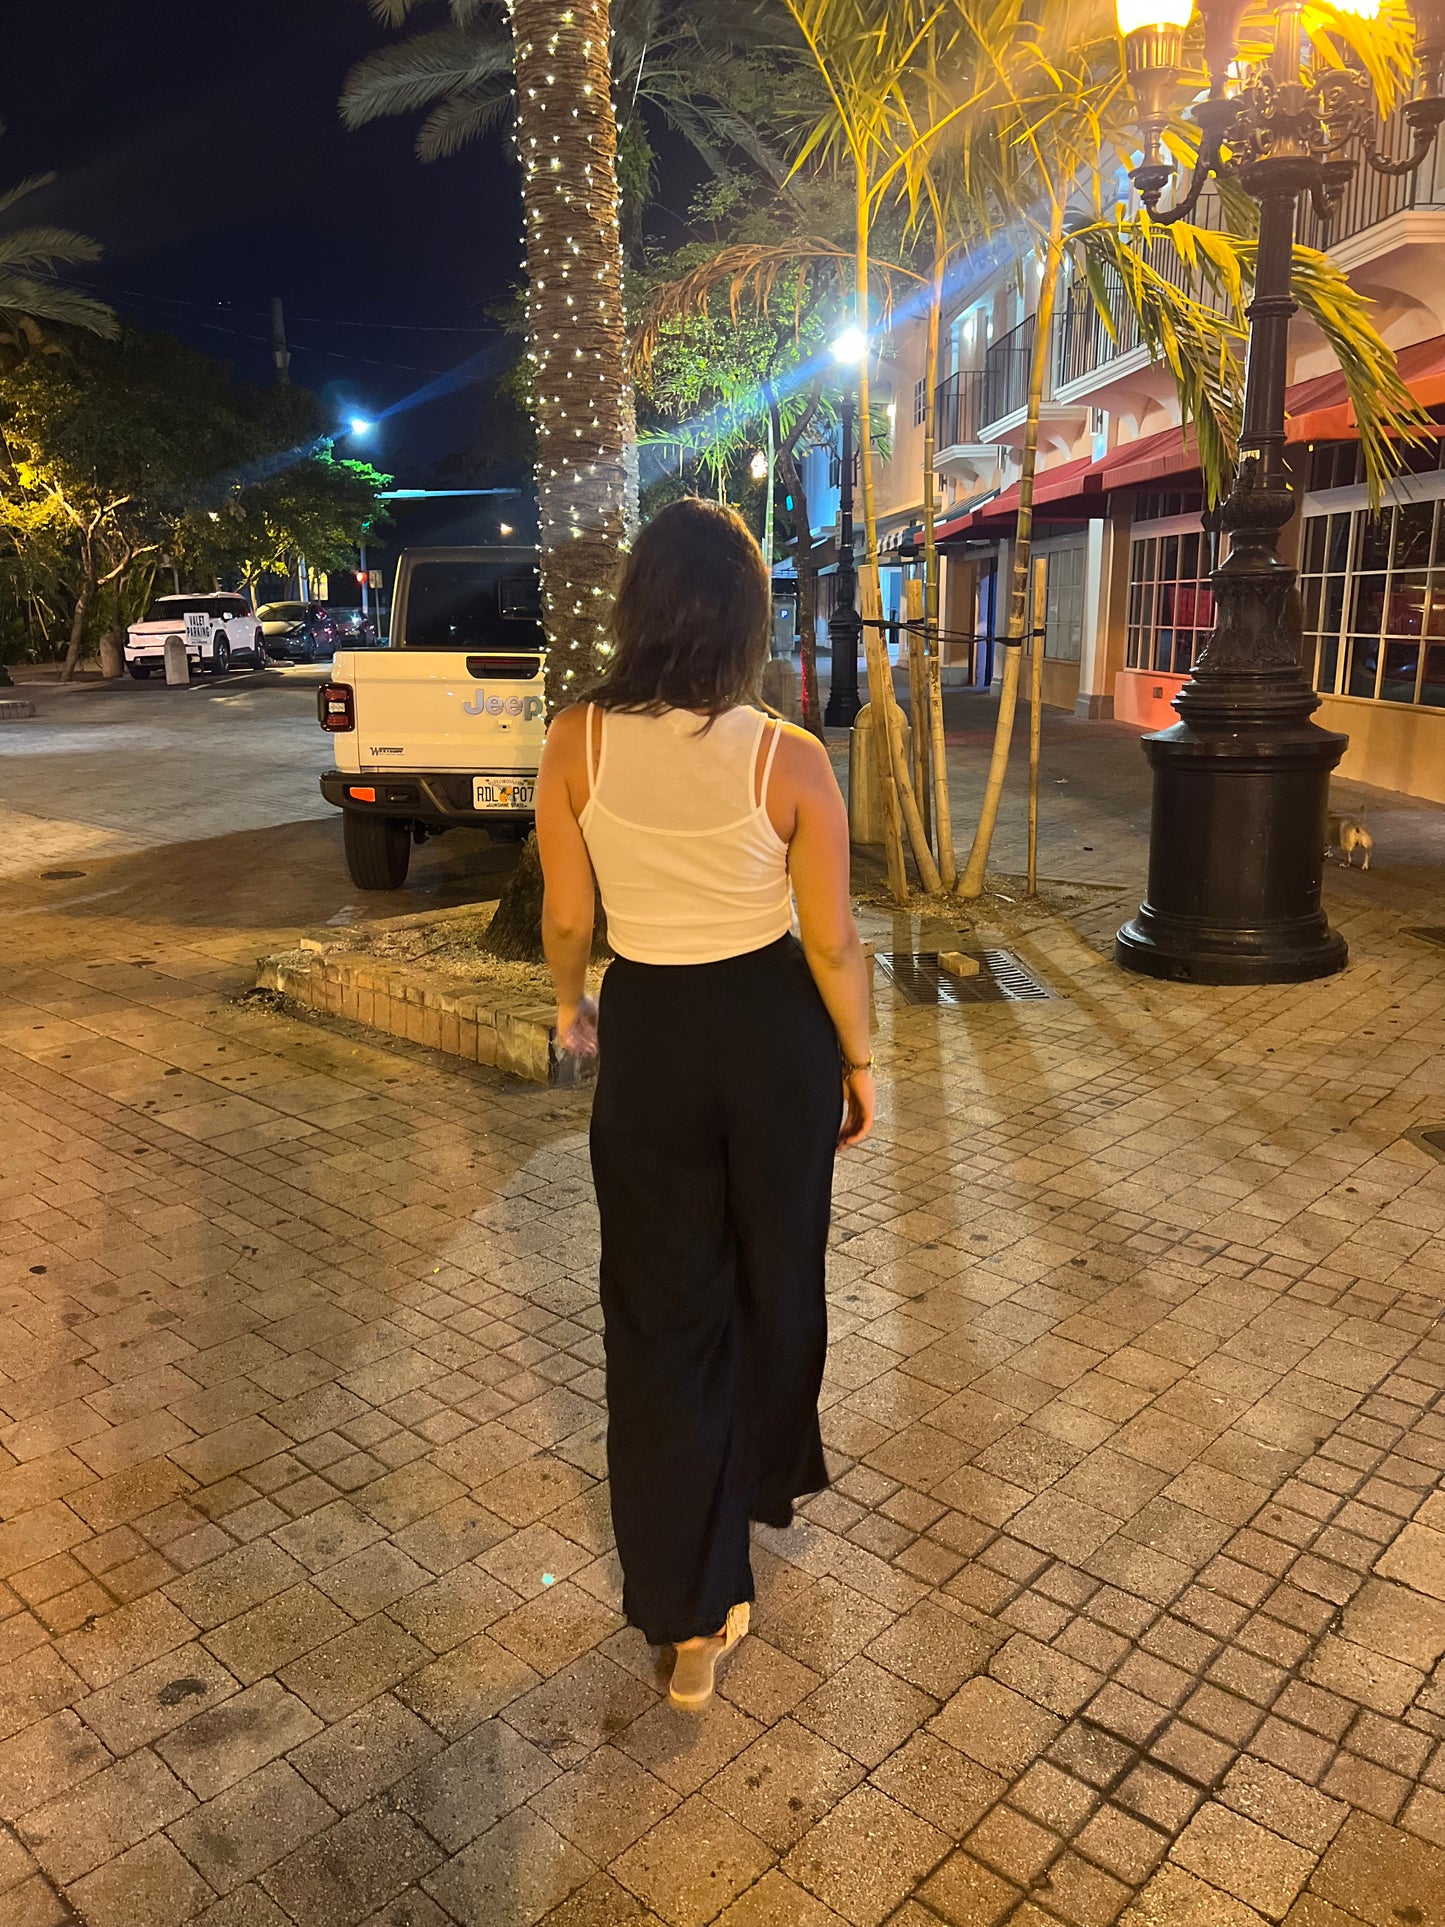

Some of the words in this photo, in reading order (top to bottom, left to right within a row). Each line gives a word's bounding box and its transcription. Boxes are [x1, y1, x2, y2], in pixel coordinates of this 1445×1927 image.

[189, 615, 204, 626] VALET
[187, 626, 210, 637] PARKING
[463, 689, 543, 721] Jeep
[477, 787, 498, 802] RDL
